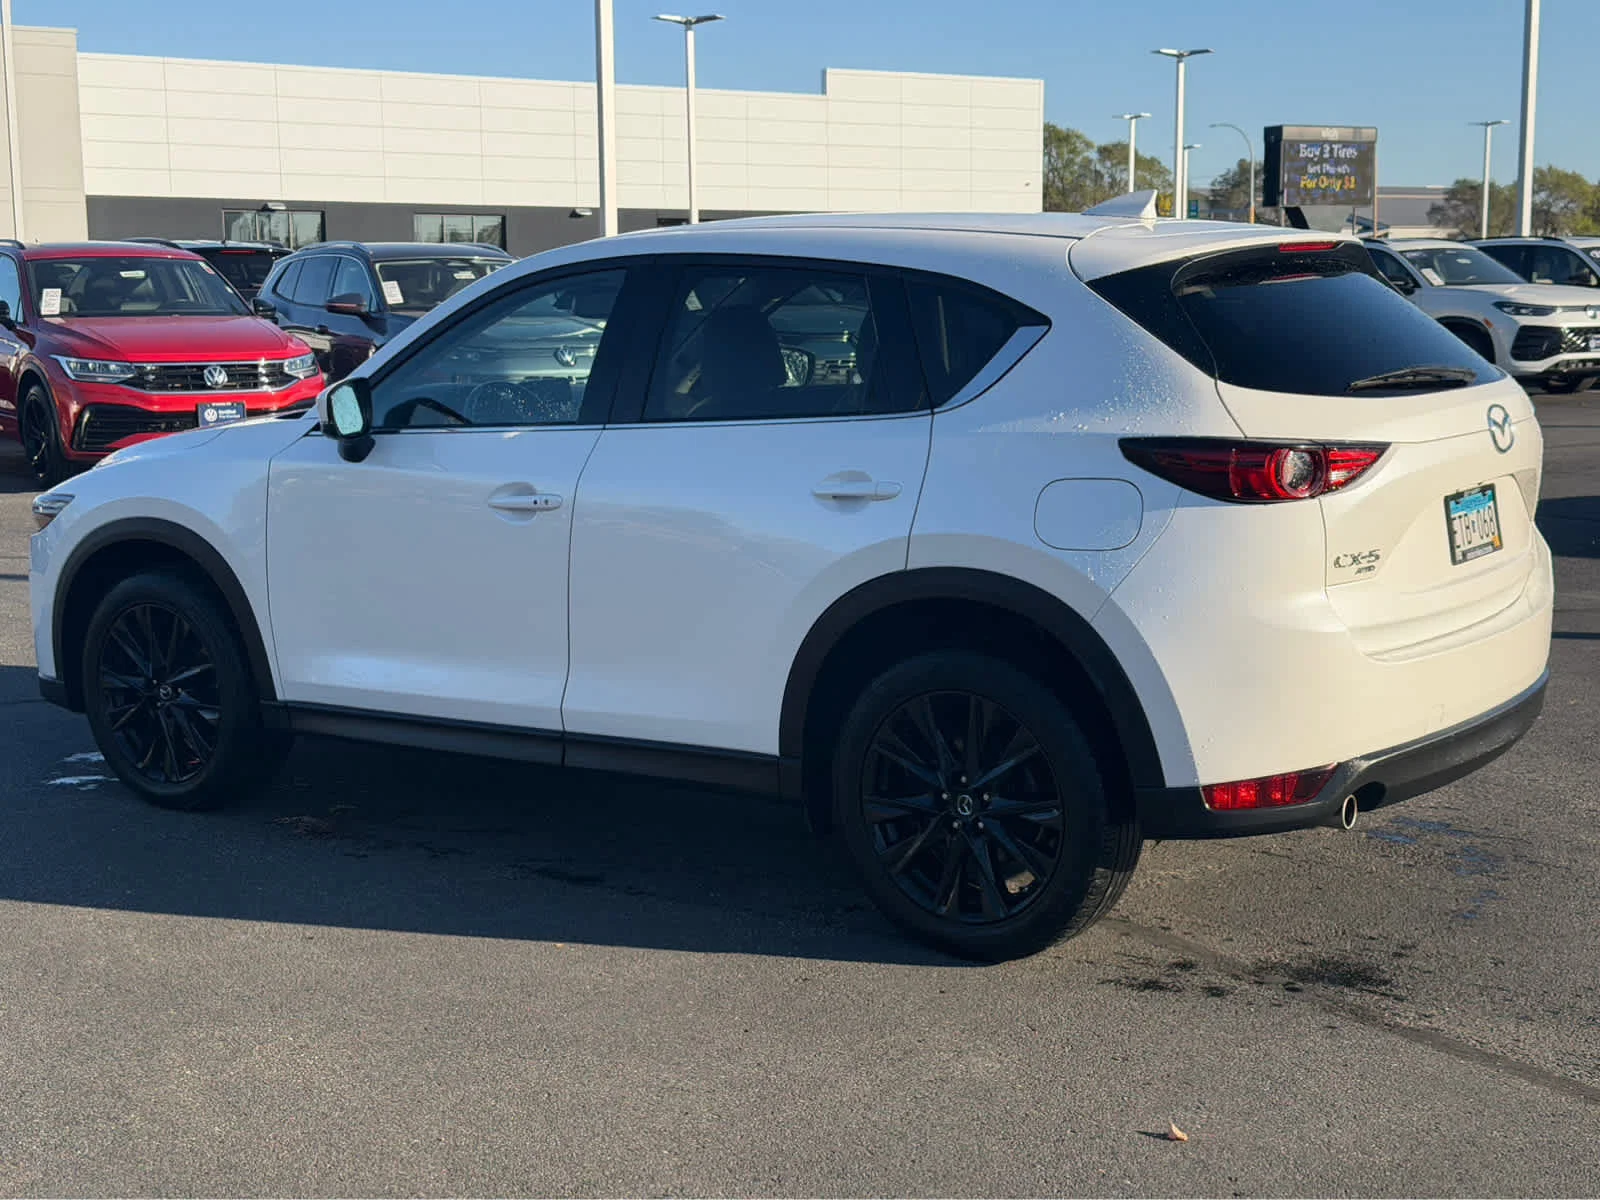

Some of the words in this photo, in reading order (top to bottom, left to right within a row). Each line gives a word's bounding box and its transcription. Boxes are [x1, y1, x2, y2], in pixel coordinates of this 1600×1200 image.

[1299, 144, 1320, 161] Buy
[1332, 144, 1358, 158] Tires
[1333, 549, 1381, 569] CX-5
